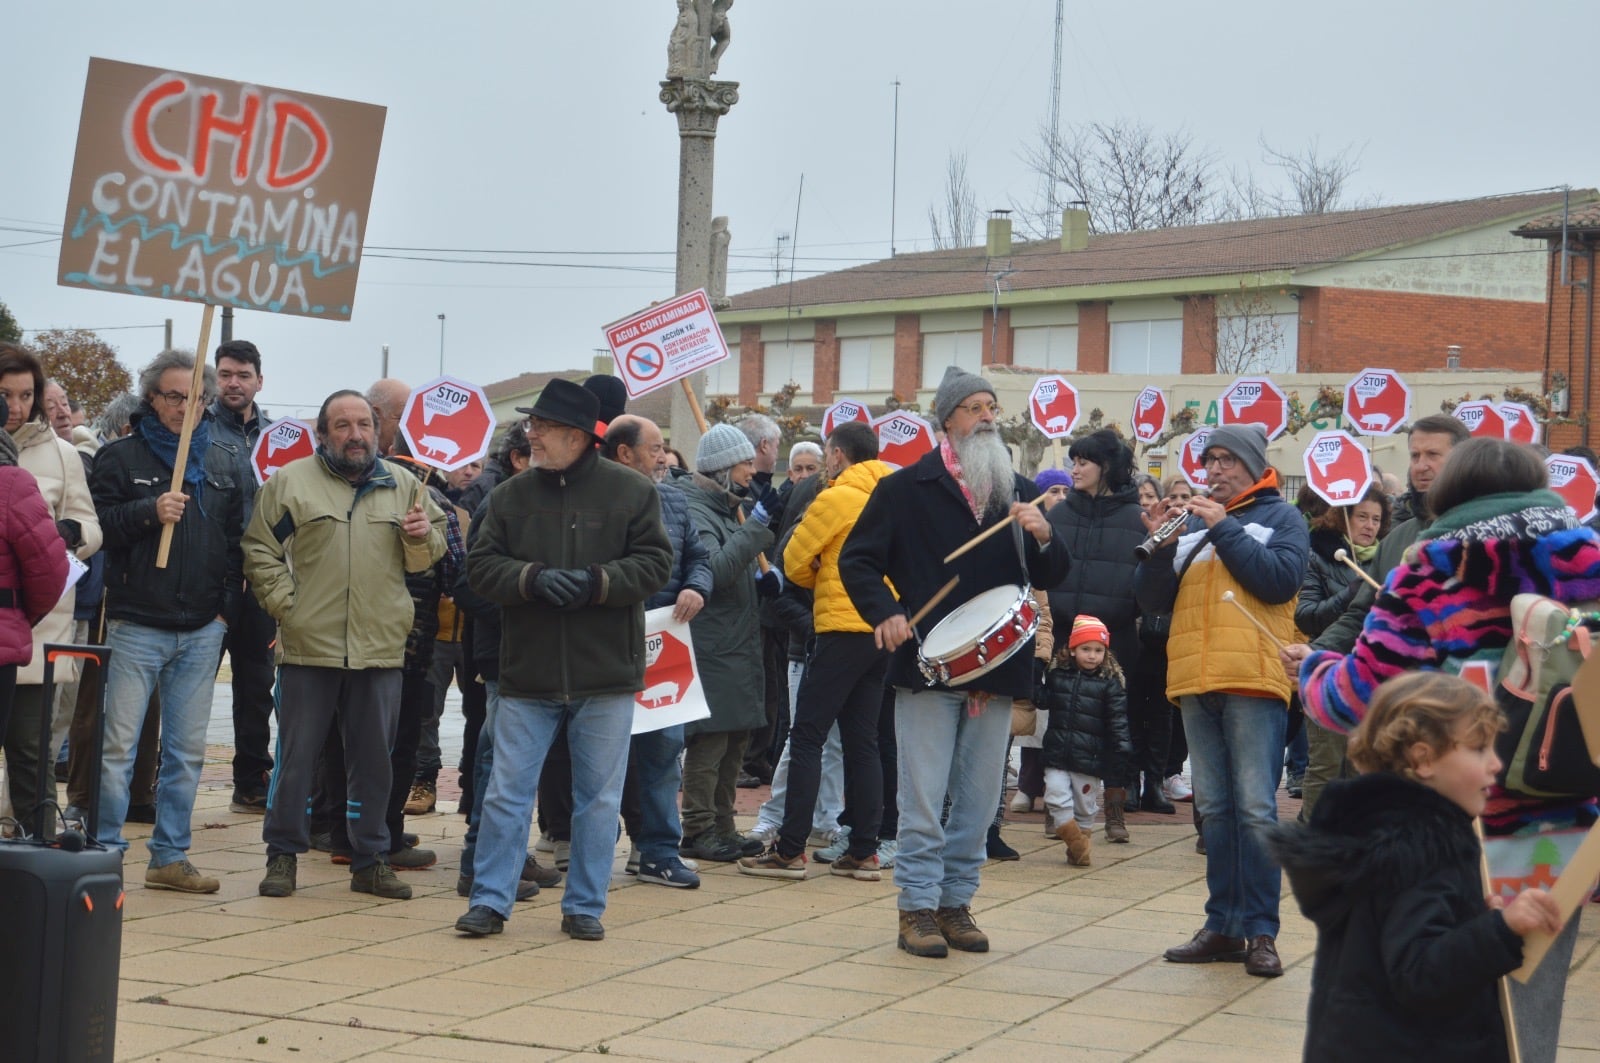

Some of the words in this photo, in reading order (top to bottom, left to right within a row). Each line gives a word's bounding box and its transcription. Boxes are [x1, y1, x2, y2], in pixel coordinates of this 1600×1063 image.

[124, 74, 332, 191] CHD
[89, 231, 153, 287] EL
[175, 246, 309, 312] AGUA
[615, 327, 639, 343] AGUA
[640, 300, 702, 332] CONTAMINADA
[666, 347, 680, 358] POR
[680, 335, 709, 352] NITRATOS
[1040, 384, 1057, 394] STOP
[1363, 376, 1387, 388] STOP
[436, 386, 469, 406] STOP
[1237, 386, 1261, 396] STOP
[839, 405, 858, 417] STOP
[1461, 410, 1483, 421] STOP
[278, 425, 301, 440] STOP
[891, 419, 918, 437] STOP
[1318, 440, 1341, 452] STOP
[1550, 463, 1576, 476] STOP
